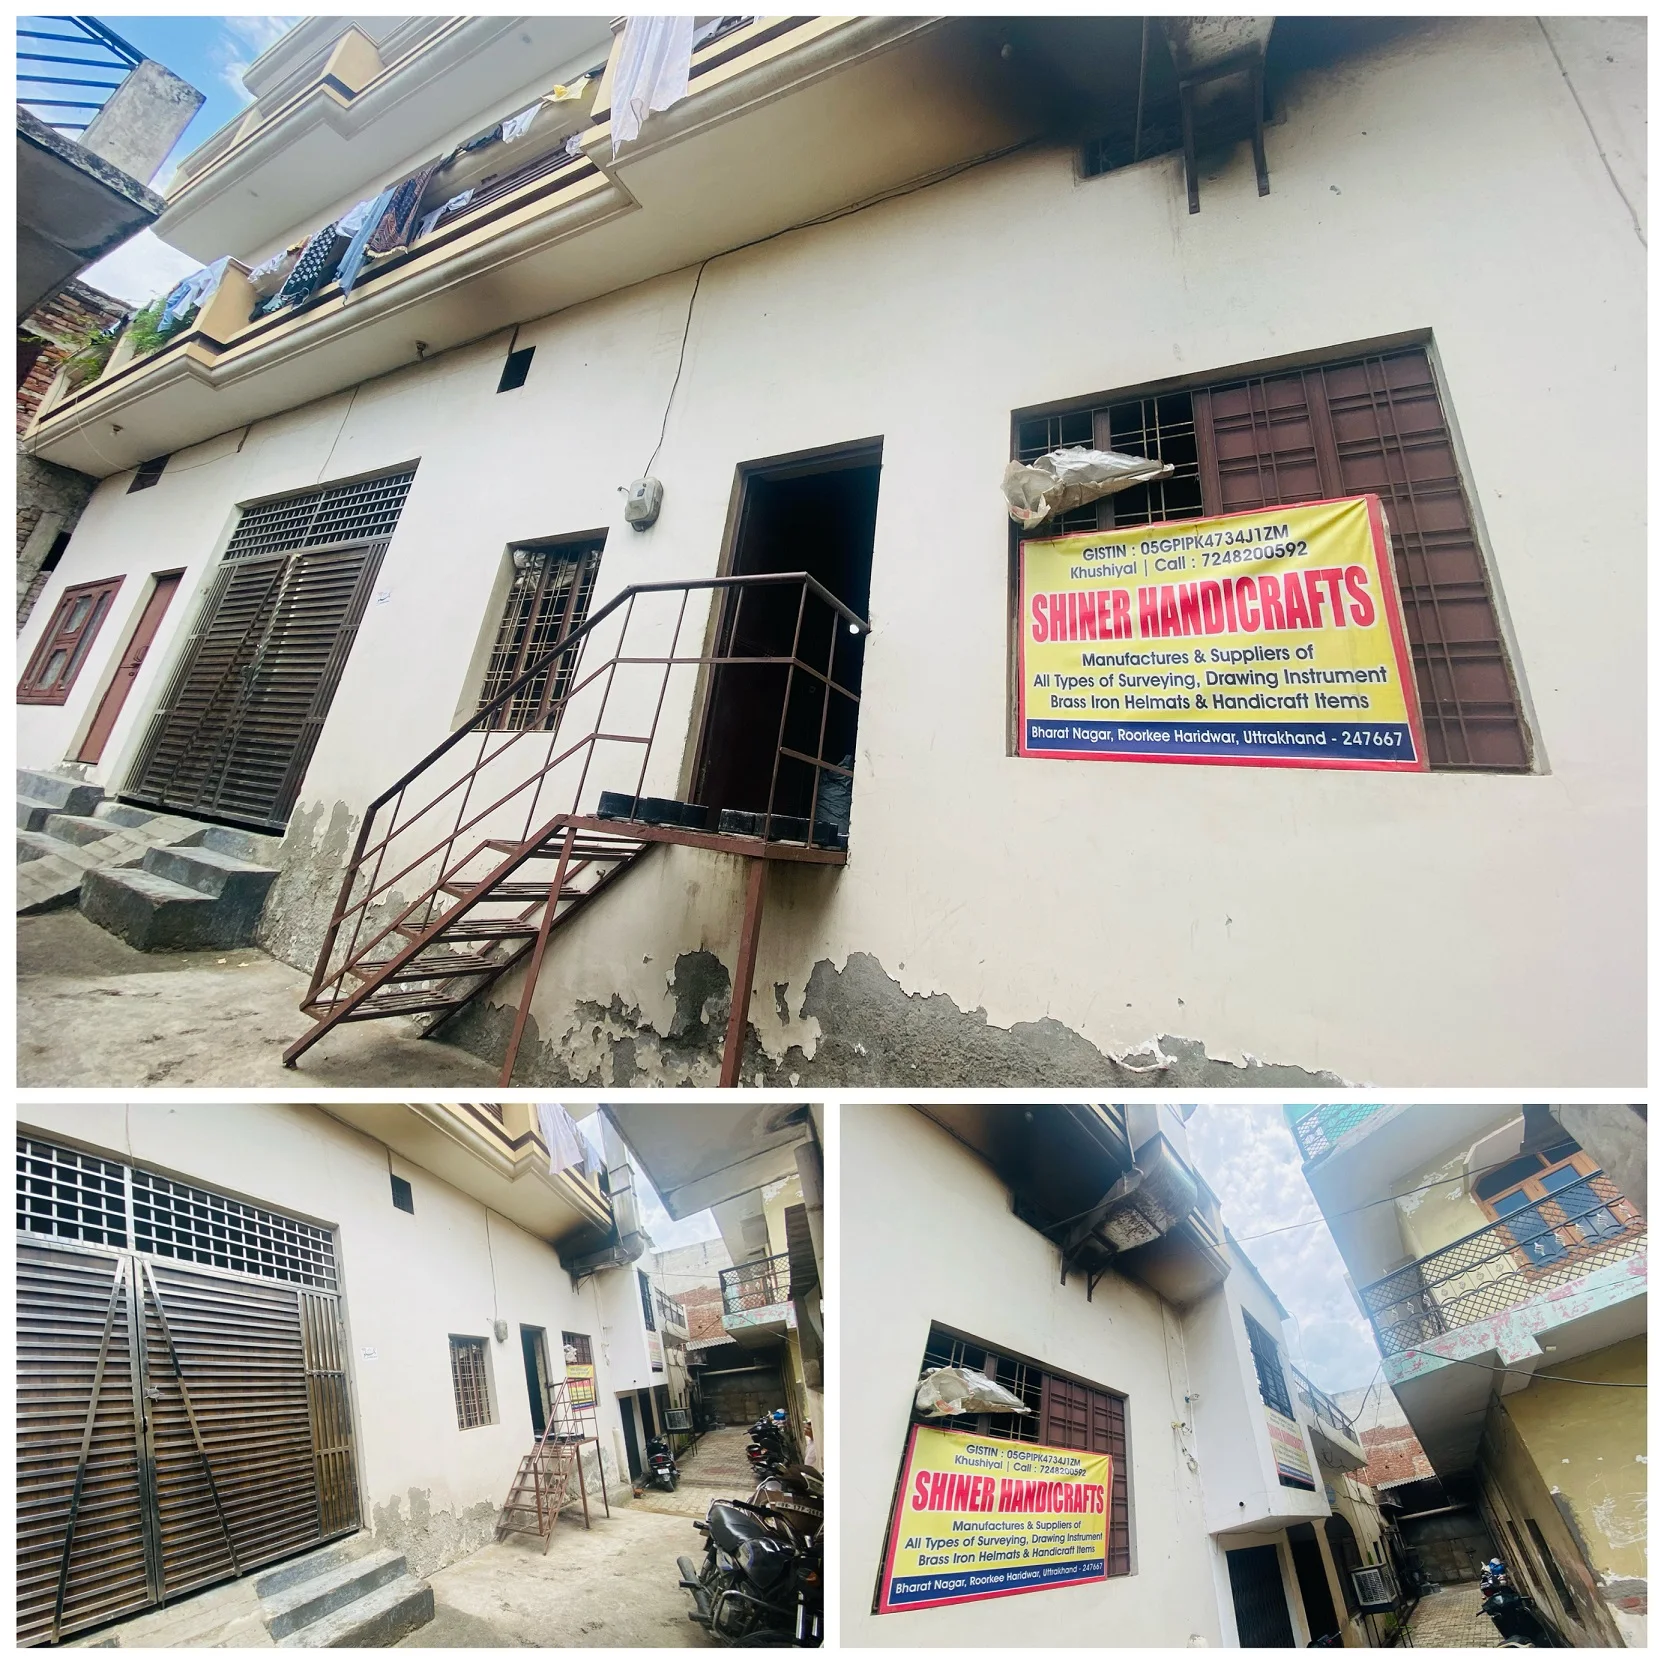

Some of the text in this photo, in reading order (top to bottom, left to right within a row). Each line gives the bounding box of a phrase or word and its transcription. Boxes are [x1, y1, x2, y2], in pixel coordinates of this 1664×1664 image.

[1083, 544, 1127, 561] GISTIN
[1140, 524, 1289, 556] 05GPIPK4734J1ZM
[1070, 561, 1137, 579] Khushiyal
[1154, 556, 1186, 572] Call
[1201, 541, 1308, 568] 7248200592
[1032, 565, 1376, 643] SHINER HANDICRAFTS
[1082, 644, 1314, 667] Manufactures & Suppliers of
[1033, 666, 1387, 690] All Types of Surveying, Drawing Instrument
[1050, 692, 1370, 710] Brass Iron Helmats & Handicraft Items
[1032, 726, 1069, 739] Bharat
[1073, 727, 1114, 743] Nagar,
[1118, 728, 1171, 742] Roorkee
[1174, 729, 1239, 745] Haridwar,
[1243, 730, 1327, 745] Uttrakhand
[1341, 731, 1402, 746] 247667
[966, 1444, 999, 1458] GISTIN
[954, 1455, 1003, 1470] Khushiyal
[1013, 1462, 1032, 1473] Call
[1040, 1466, 1087, 1477] 7248200592
[912, 1470, 1104, 1514] SHINER HANDICRAFTS
[952, 1520, 1081, 1531] Manufactures & Suppliers of
[905, 1532, 1103, 1550] All Types of Surveying, Drawing Instrument
[918, 1545, 1096, 1566] Brass Iron Helmats & Handicraft Items
[896, 1581, 931, 1594] Bharat
[934, 1579, 967, 1590] Nagar,
[969, 1575, 1004, 1586] Roorkee
[1006, 1571, 1041, 1581] Haridwar,
[1043, 1565, 1078, 1576] Uttrakhand
[1082, 1562, 1103, 1572] 247667
